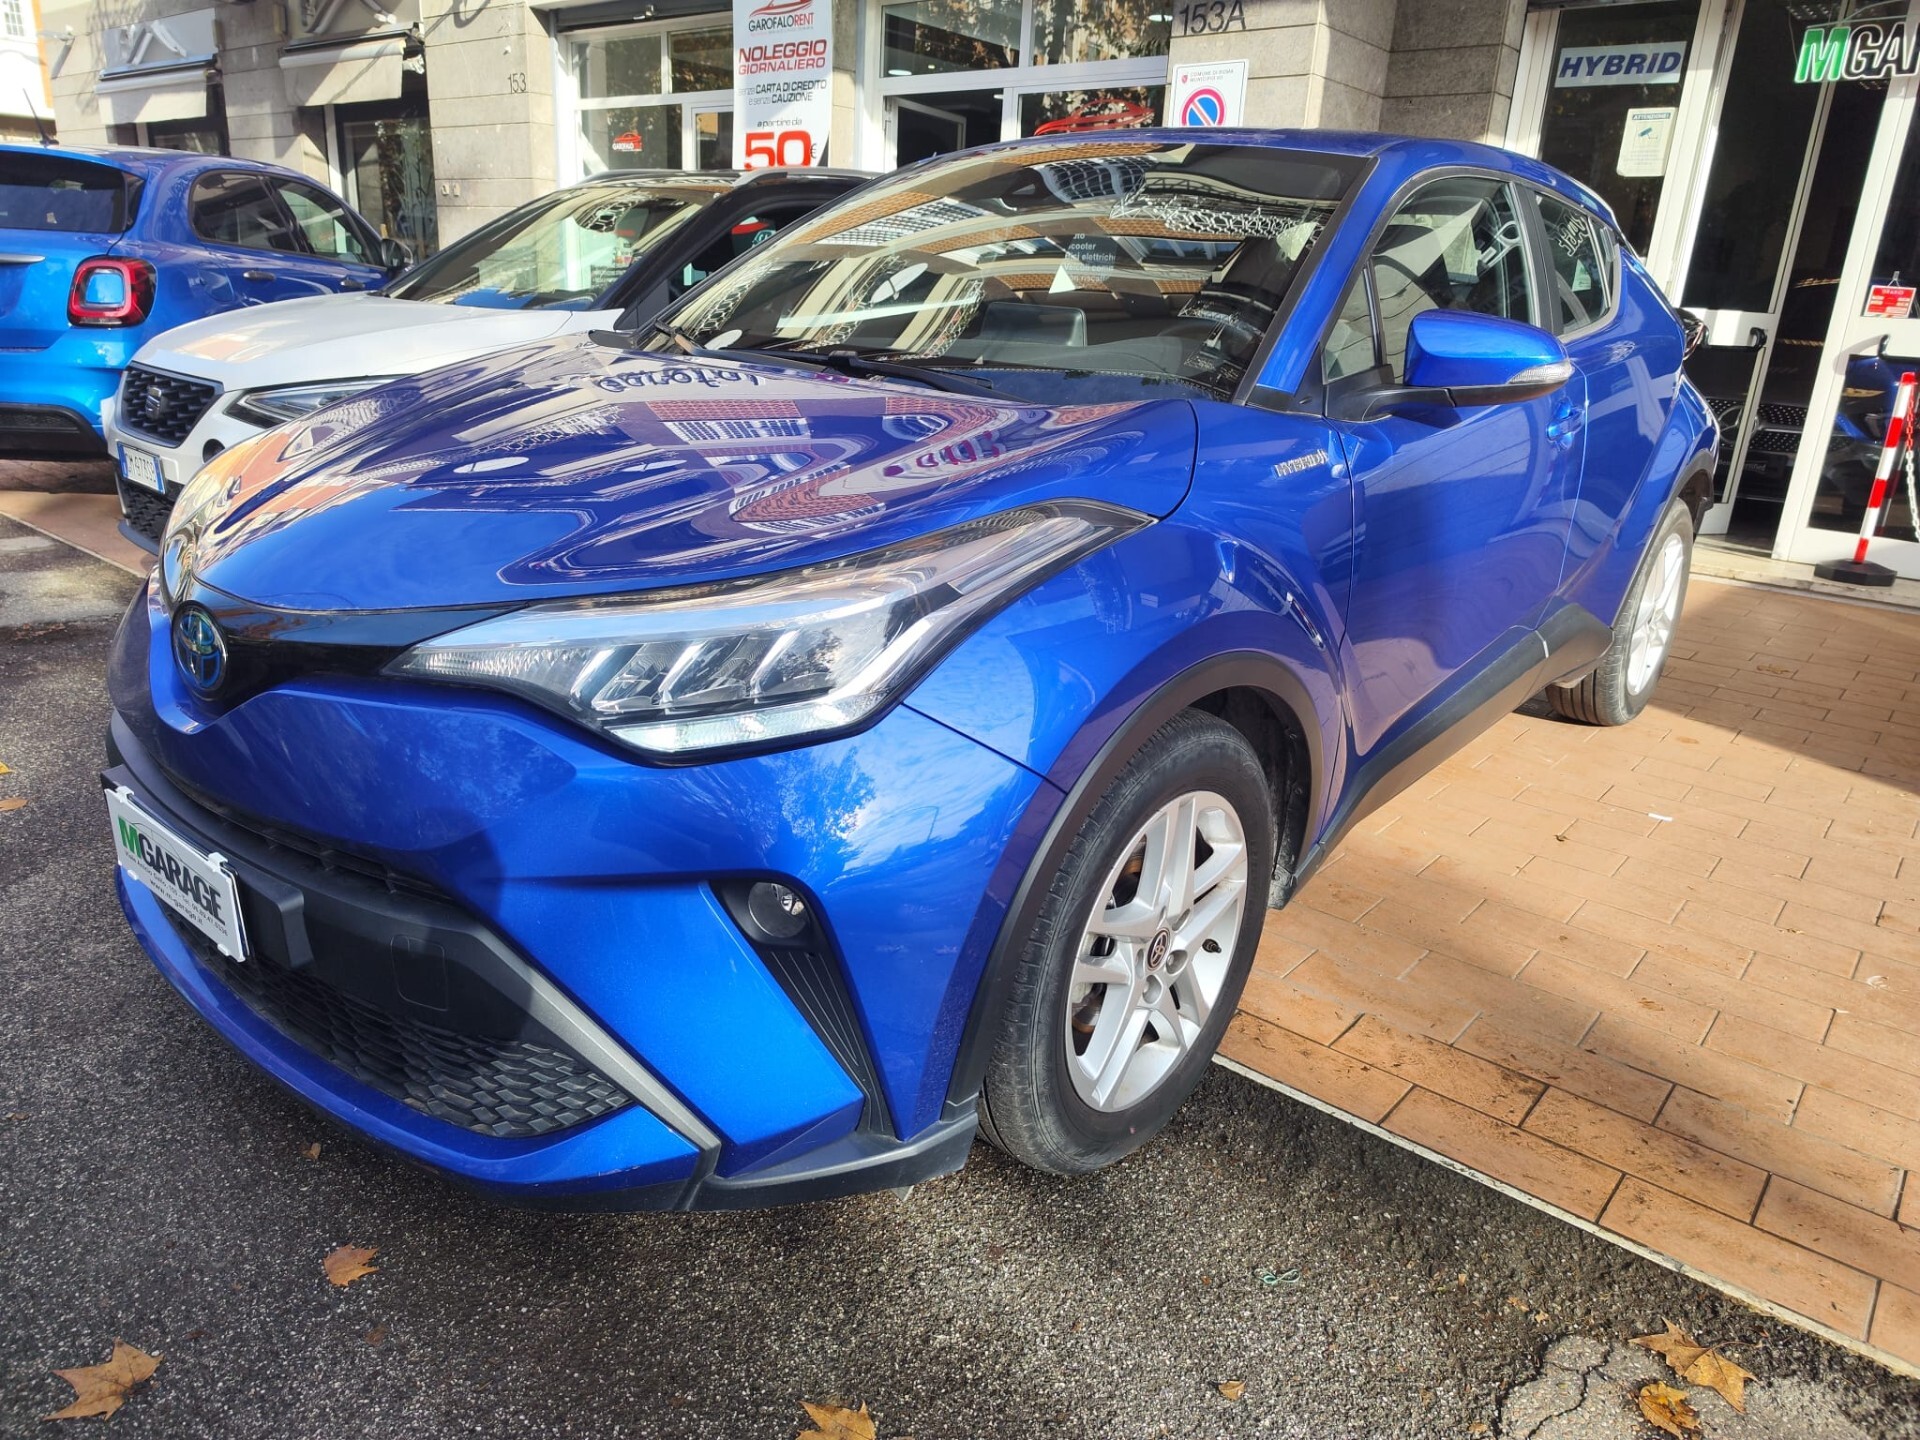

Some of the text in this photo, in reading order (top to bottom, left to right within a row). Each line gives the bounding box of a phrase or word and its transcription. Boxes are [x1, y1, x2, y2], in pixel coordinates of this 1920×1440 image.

[748, 12, 815, 32] GAROFALORENT
[1179, 0, 1247, 36] 153A
[738, 39, 827, 63] NOLEGGIO
[1794, 21, 1920, 83] MGA
[738, 57, 826, 76] GIORNALIERO
[1559, 51, 1682, 78] HYBRID
[507, 72, 526, 94] 153
[756, 82, 782, 94] CARTA
[782, 81, 790, 92] DI
[791, 79, 827, 91] CREDITO
[772, 91, 813, 104] CAUZIONE
[118, 815, 226, 926] MGARAGE
